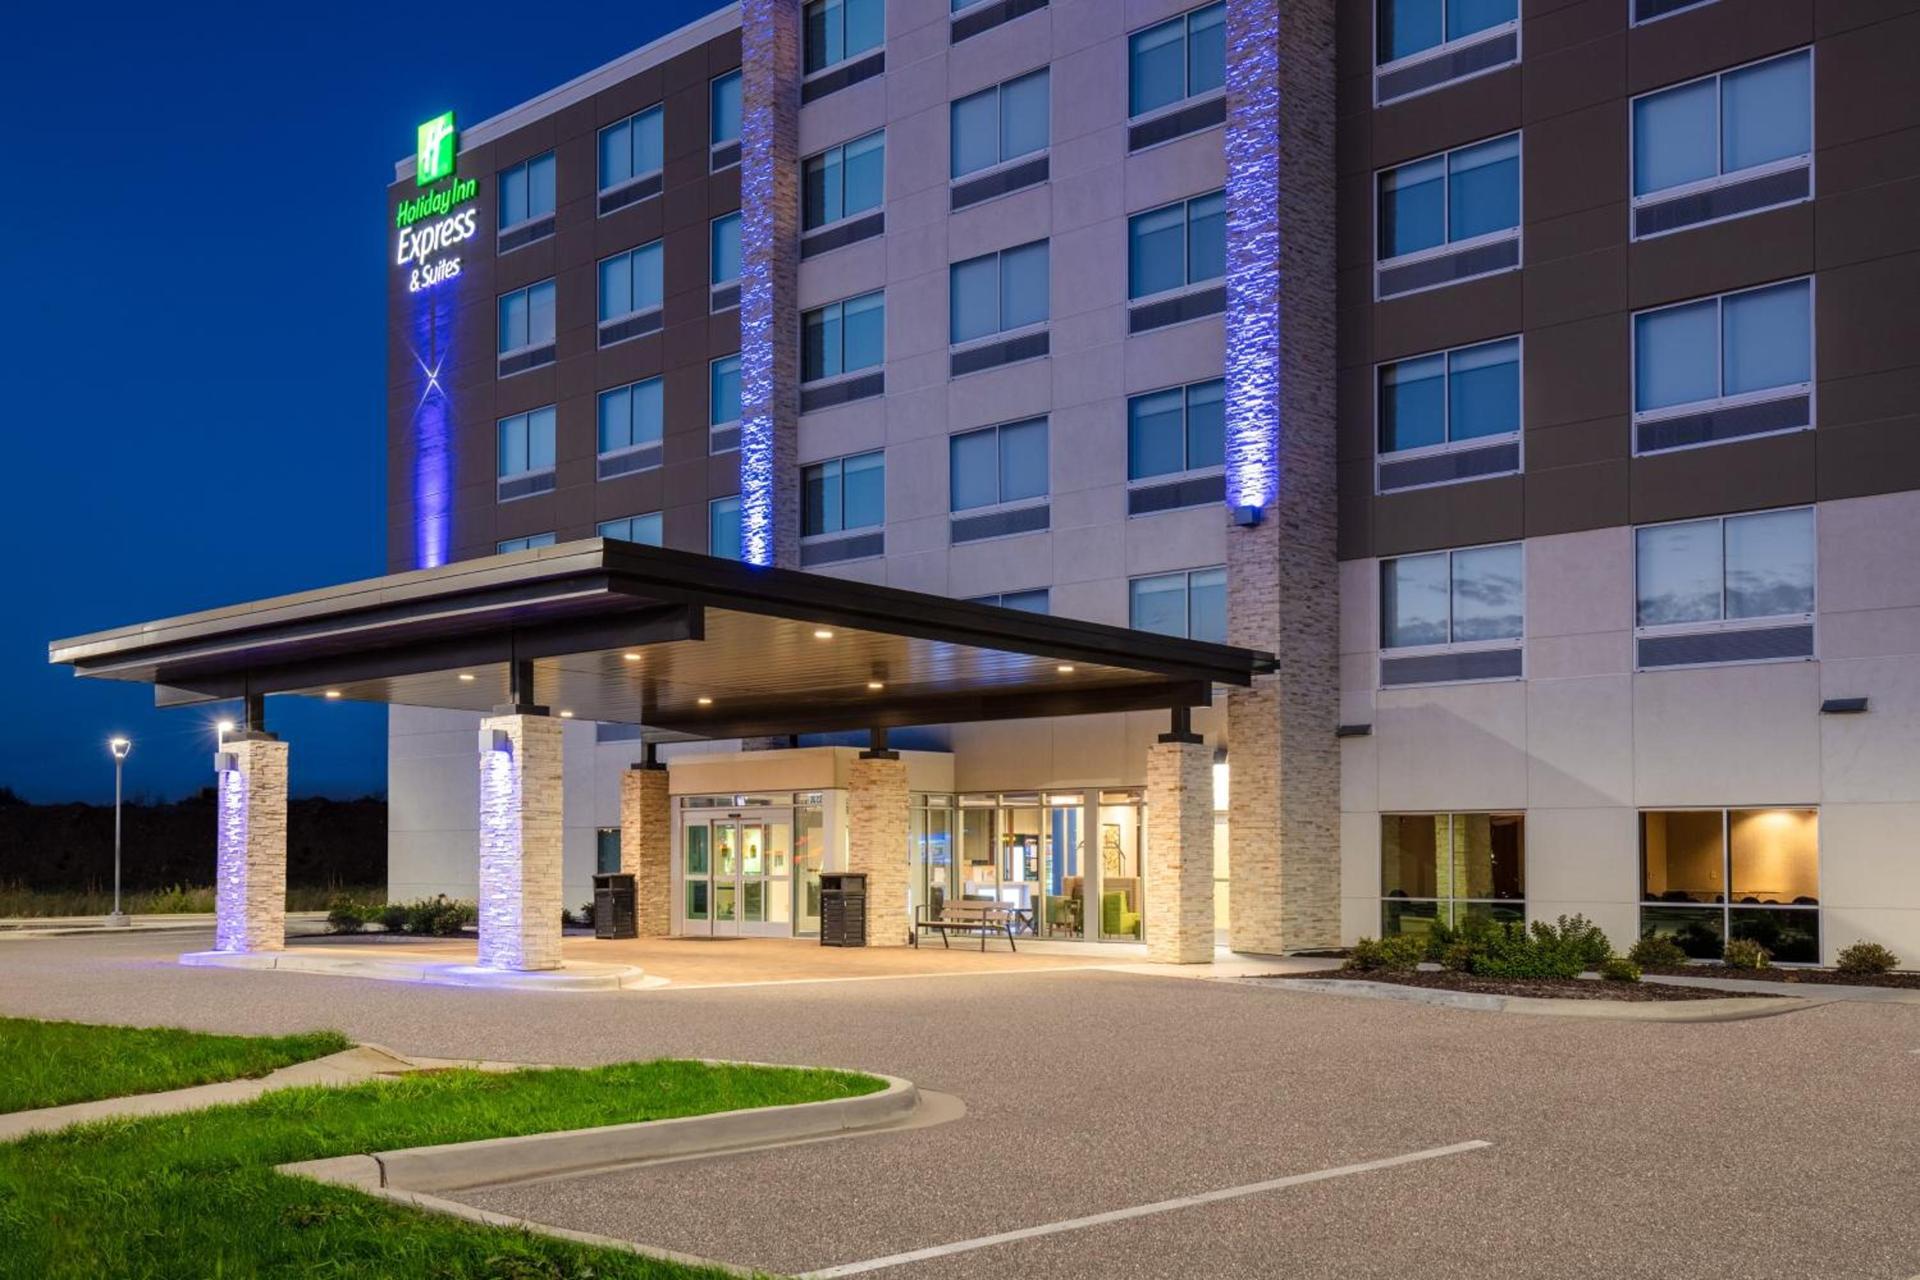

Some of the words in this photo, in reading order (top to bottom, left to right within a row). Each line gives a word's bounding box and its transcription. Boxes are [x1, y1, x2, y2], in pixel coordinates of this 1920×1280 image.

[396, 188, 452, 229] Holiday
[452, 177, 477, 205] Inn
[397, 208, 476, 266] Express
[409, 269, 421, 293] &
[421, 257, 461, 288] Suites
